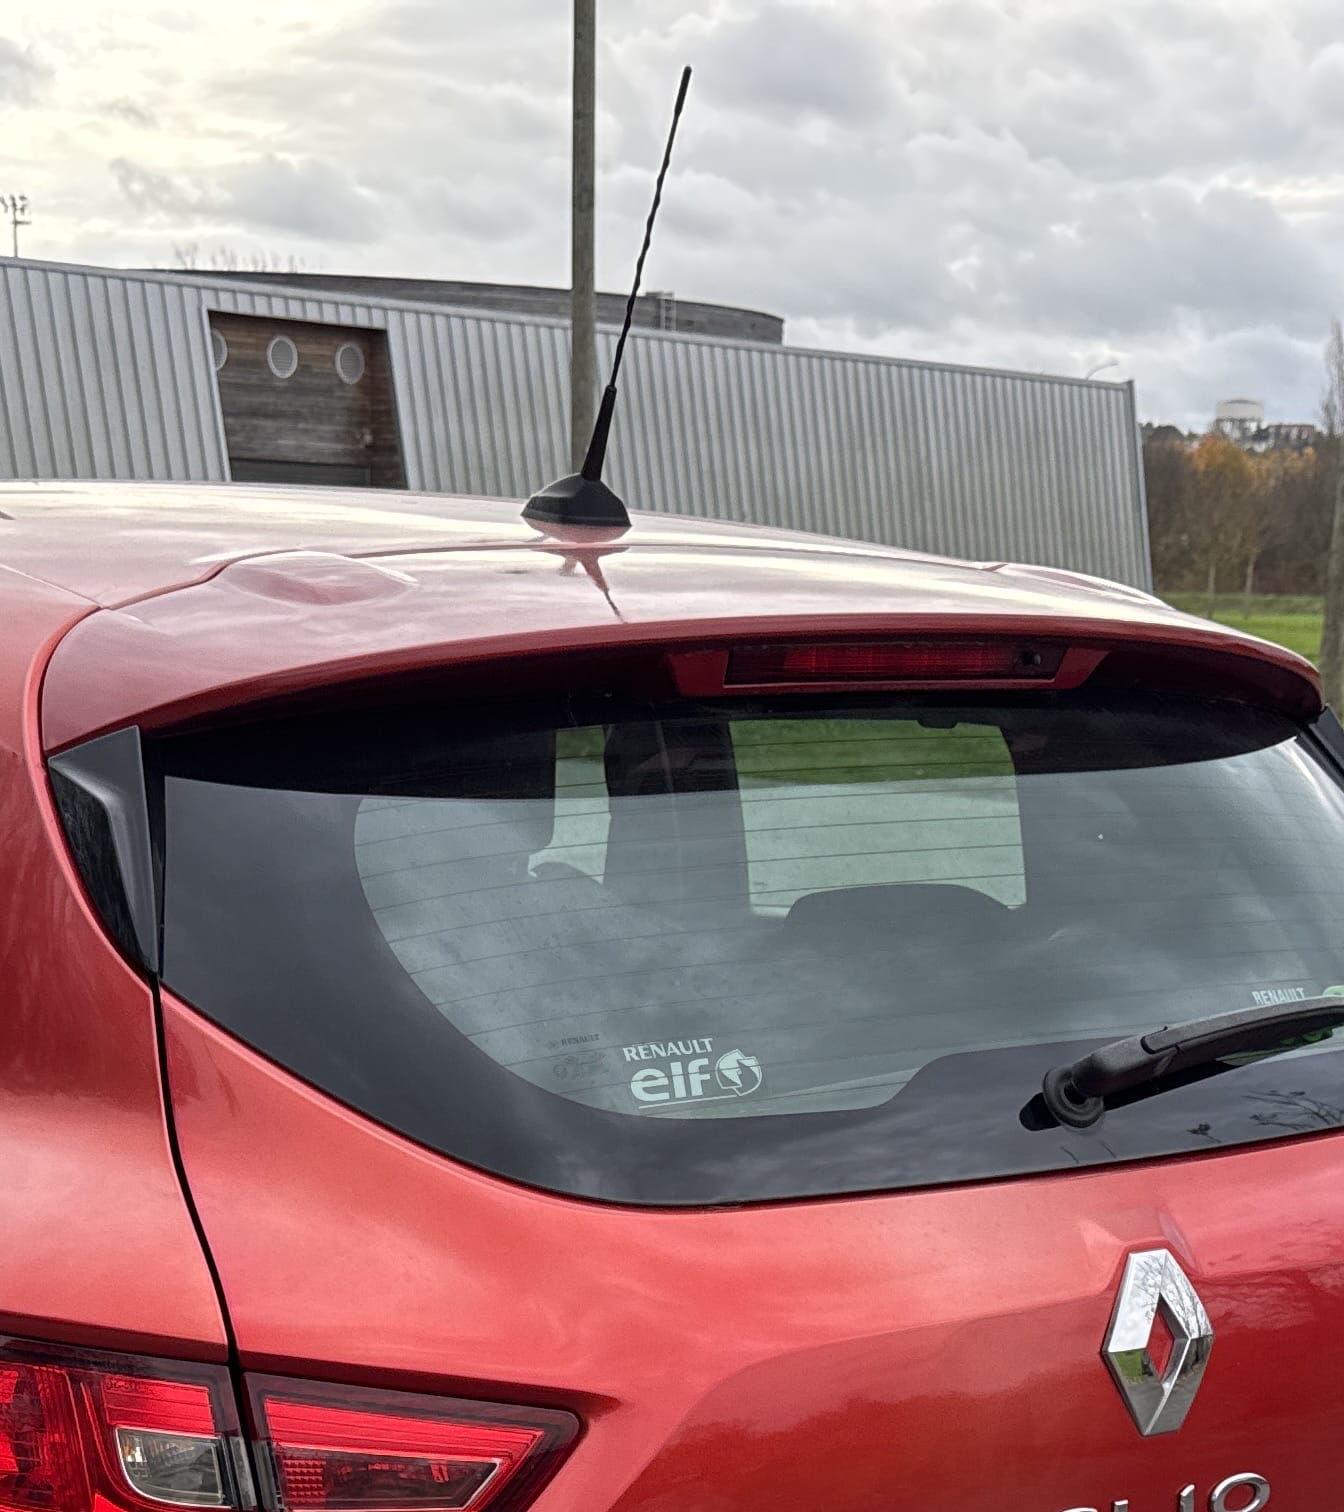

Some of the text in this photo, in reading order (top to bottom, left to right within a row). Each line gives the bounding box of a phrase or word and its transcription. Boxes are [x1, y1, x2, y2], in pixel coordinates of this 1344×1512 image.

[1252, 987, 1305, 1005] RENAULT
[623, 1038, 713, 1062] RENAULT
[630, 1058, 711, 1102] elf
